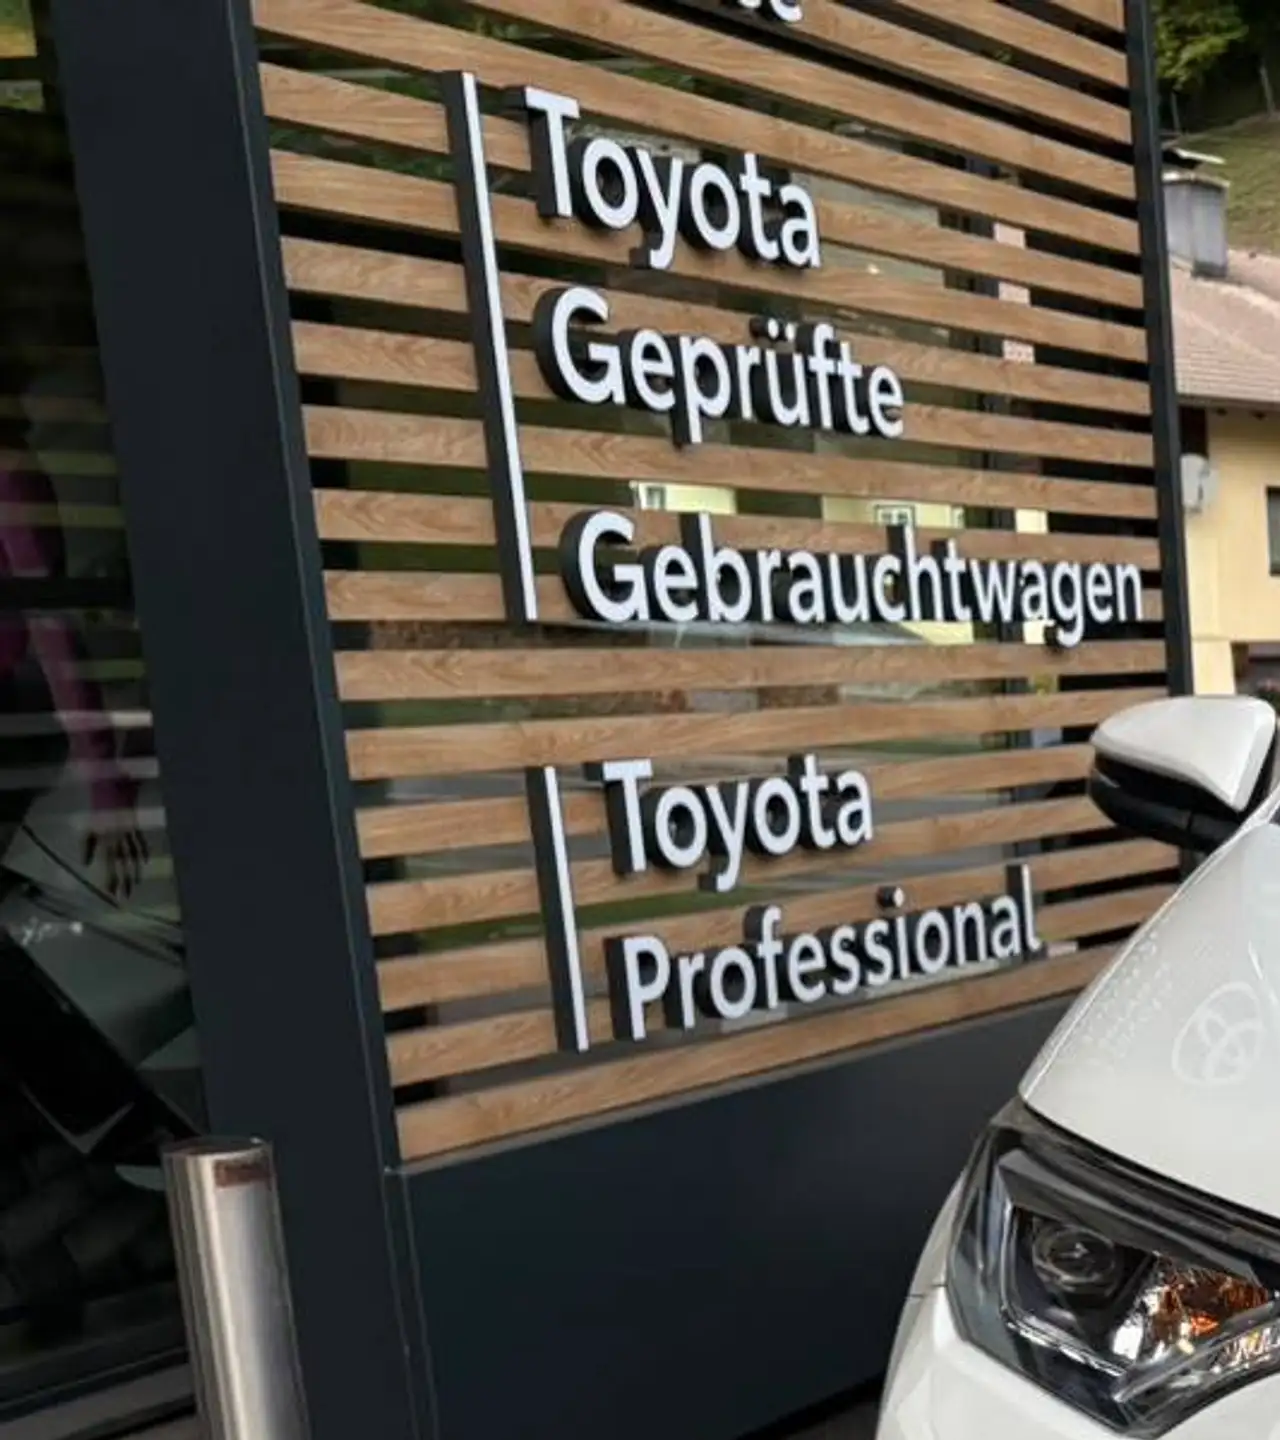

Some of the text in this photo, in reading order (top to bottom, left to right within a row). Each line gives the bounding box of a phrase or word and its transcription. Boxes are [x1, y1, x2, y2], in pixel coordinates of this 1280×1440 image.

[525, 86, 821, 270] Toyota
[552, 286, 903, 445] Geprüfte
[578, 512, 1143, 647] Gebrauchtwagen
[603, 754, 874, 893] Toyota
[622, 863, 1044, 1041] Professional
